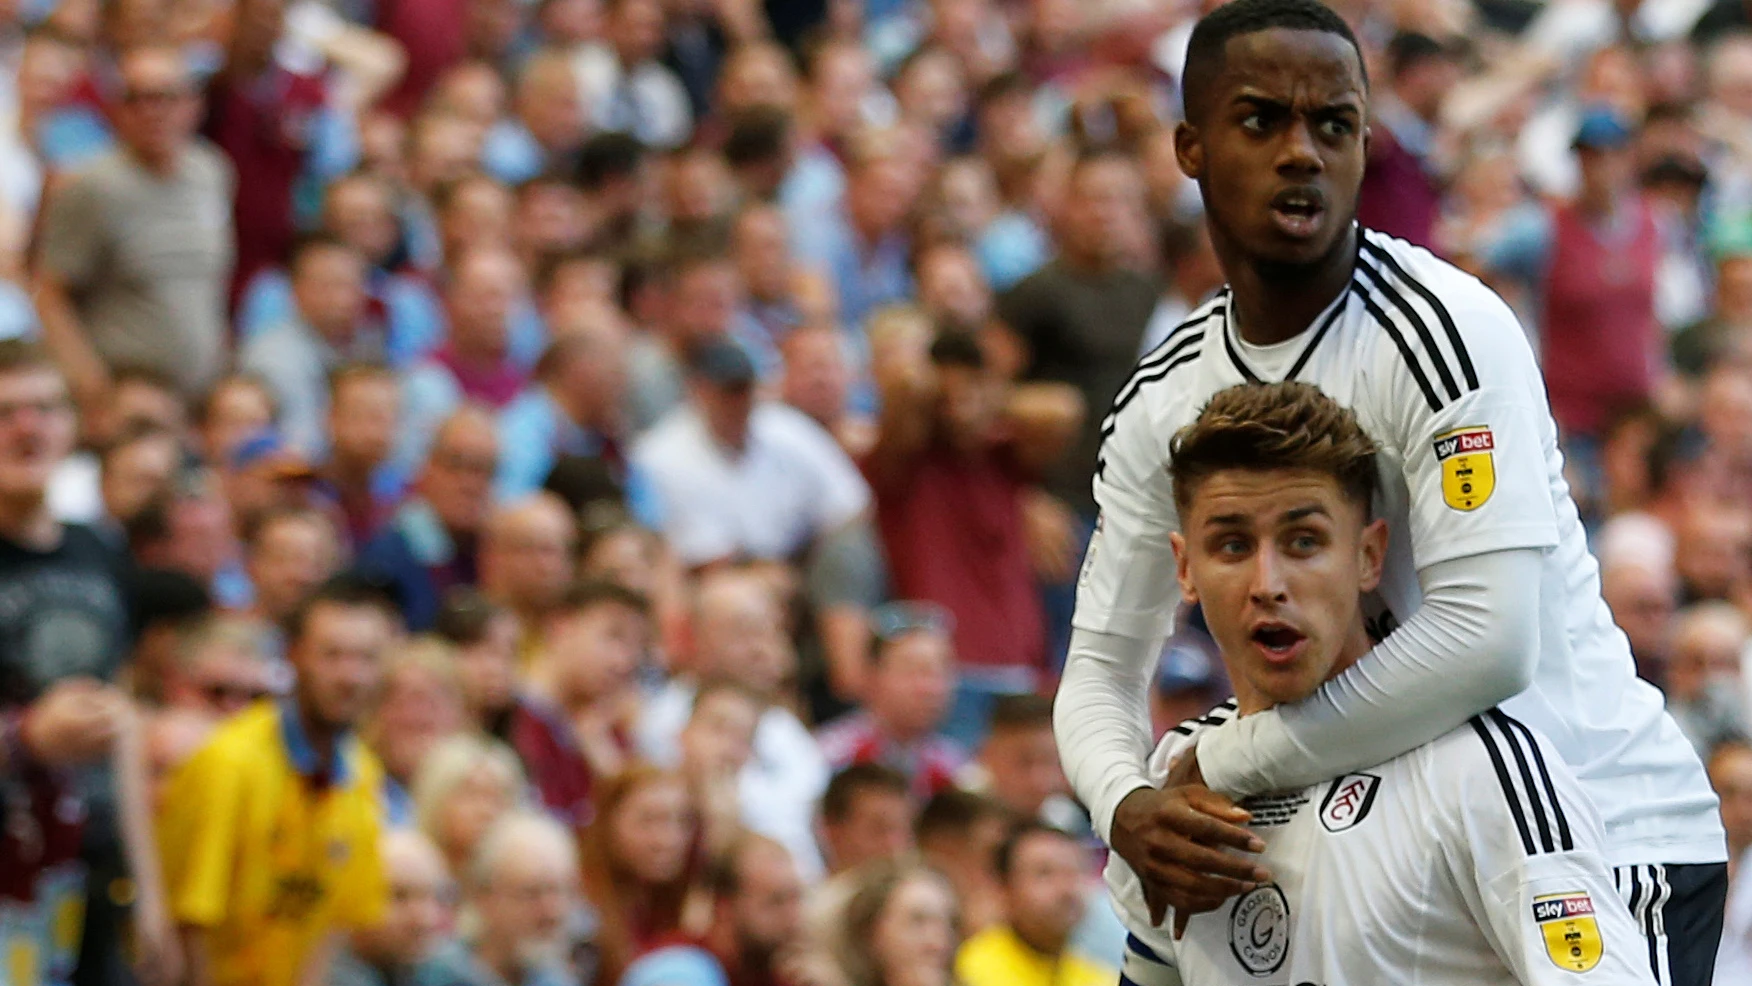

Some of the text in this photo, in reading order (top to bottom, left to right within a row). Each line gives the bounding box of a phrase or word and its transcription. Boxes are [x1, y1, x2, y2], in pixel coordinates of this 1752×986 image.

[1461, 433, 1491, 449] bet
[1536, 899, 1592, 918] sky bet
